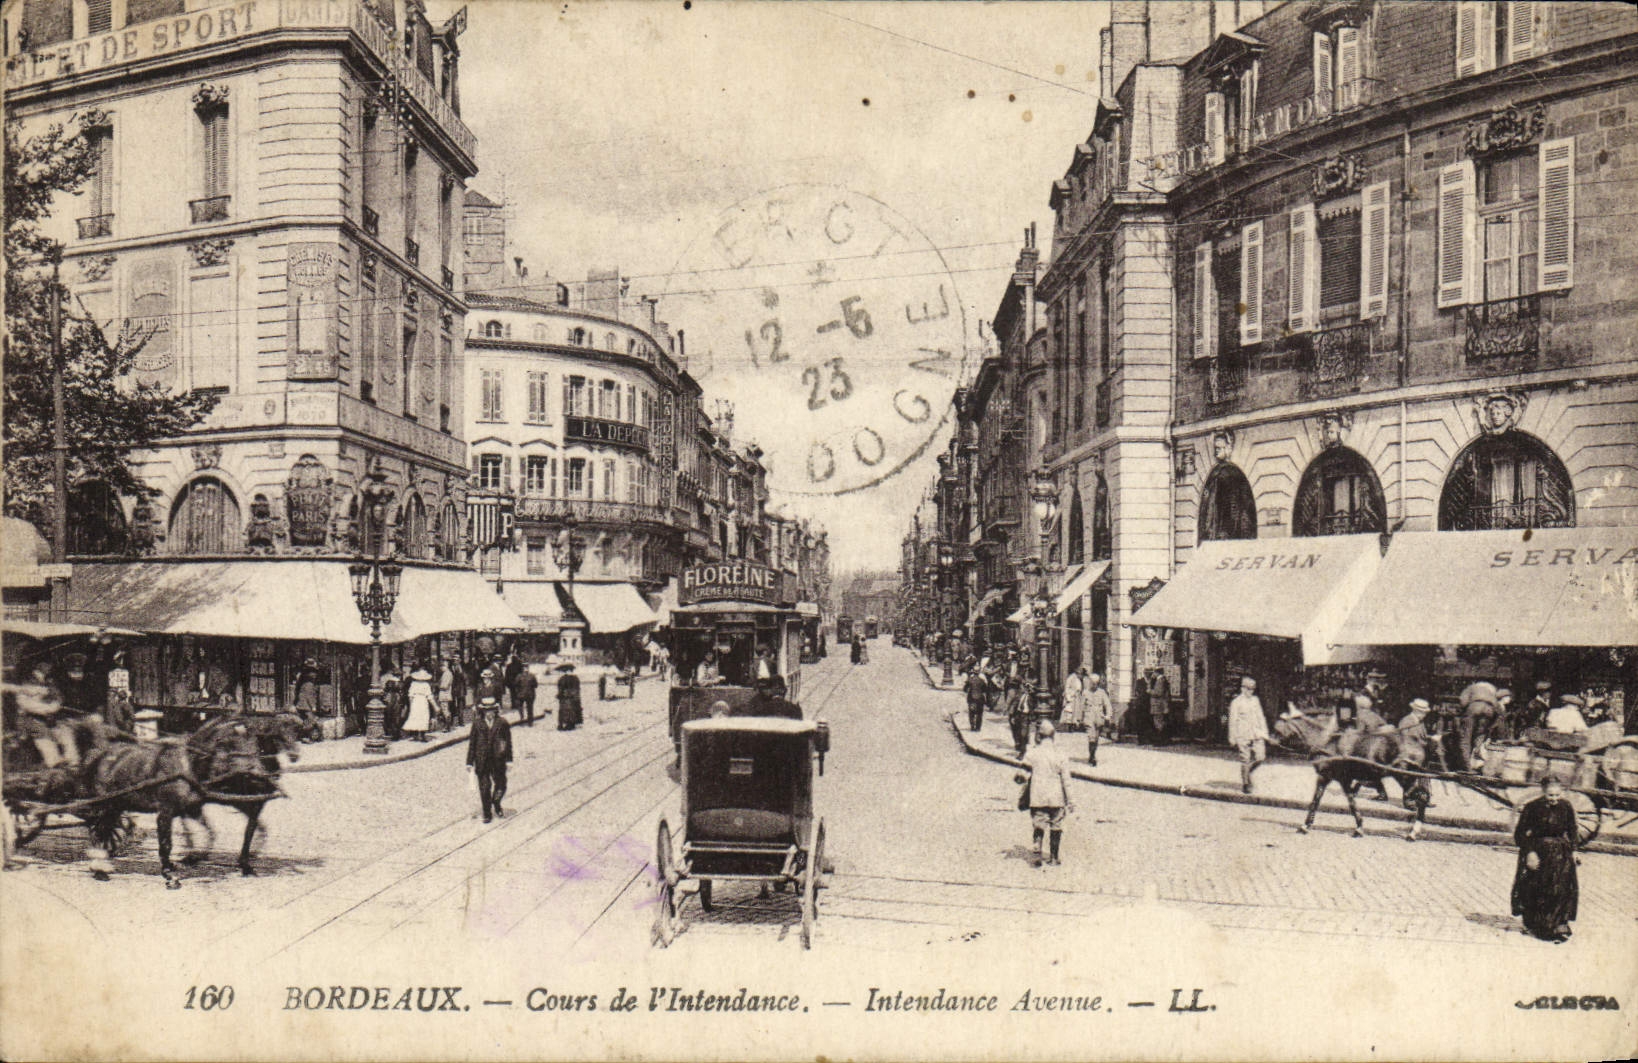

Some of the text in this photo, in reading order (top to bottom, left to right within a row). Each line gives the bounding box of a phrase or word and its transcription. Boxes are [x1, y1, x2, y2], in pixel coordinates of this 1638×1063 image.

[56, 41, 91, 78] ET
[101, 30, 139, 66] DE
[152, 2, 257, 51] SPORT
[582, 420, 604, 439] LA
[291, 510, 326, 523] PARIS
[1215, 553, 1323, 571] SERVAN
